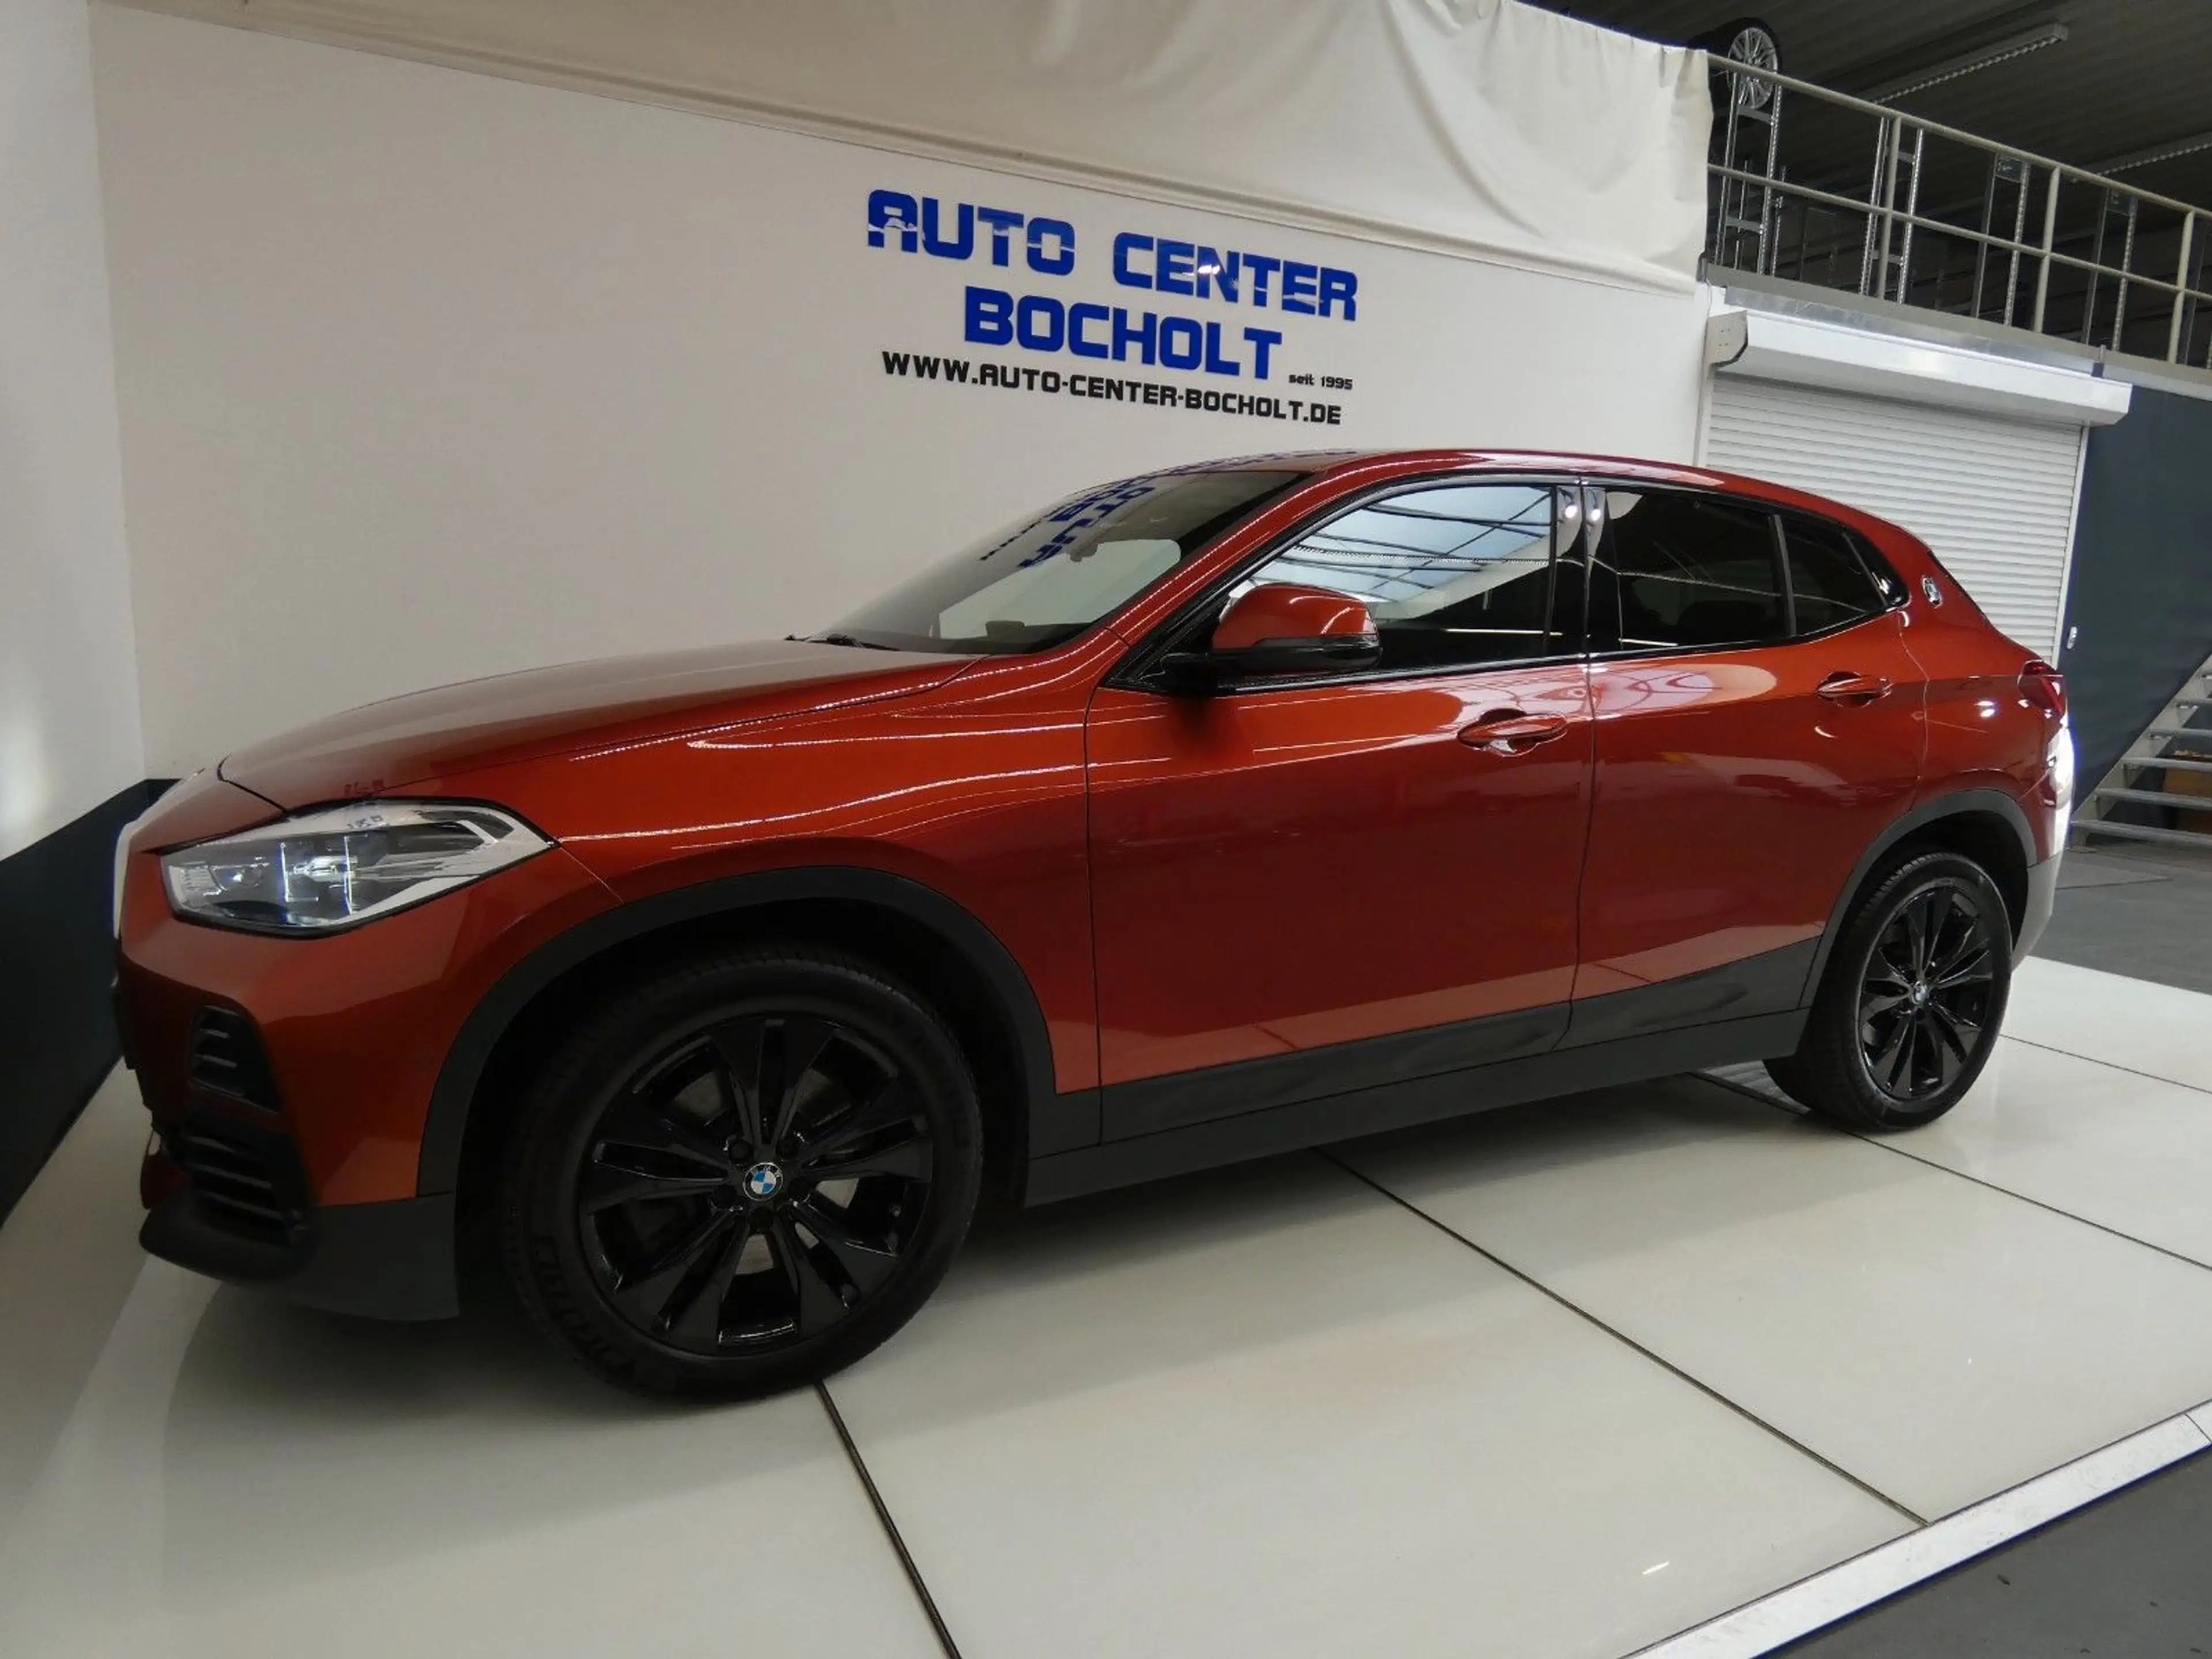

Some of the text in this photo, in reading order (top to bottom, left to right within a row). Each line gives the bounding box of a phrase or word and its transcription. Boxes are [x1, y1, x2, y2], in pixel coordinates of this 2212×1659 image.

[868, 189, 1358, 322] AUTO CENTER
[964, 286, 1283, 381] BOCHOLT
[882, 351, 1342, 425] WWW.AUTO-CENTER-BOCHOLT.DE
[1289, 373, 1353, 391] seit 1995
